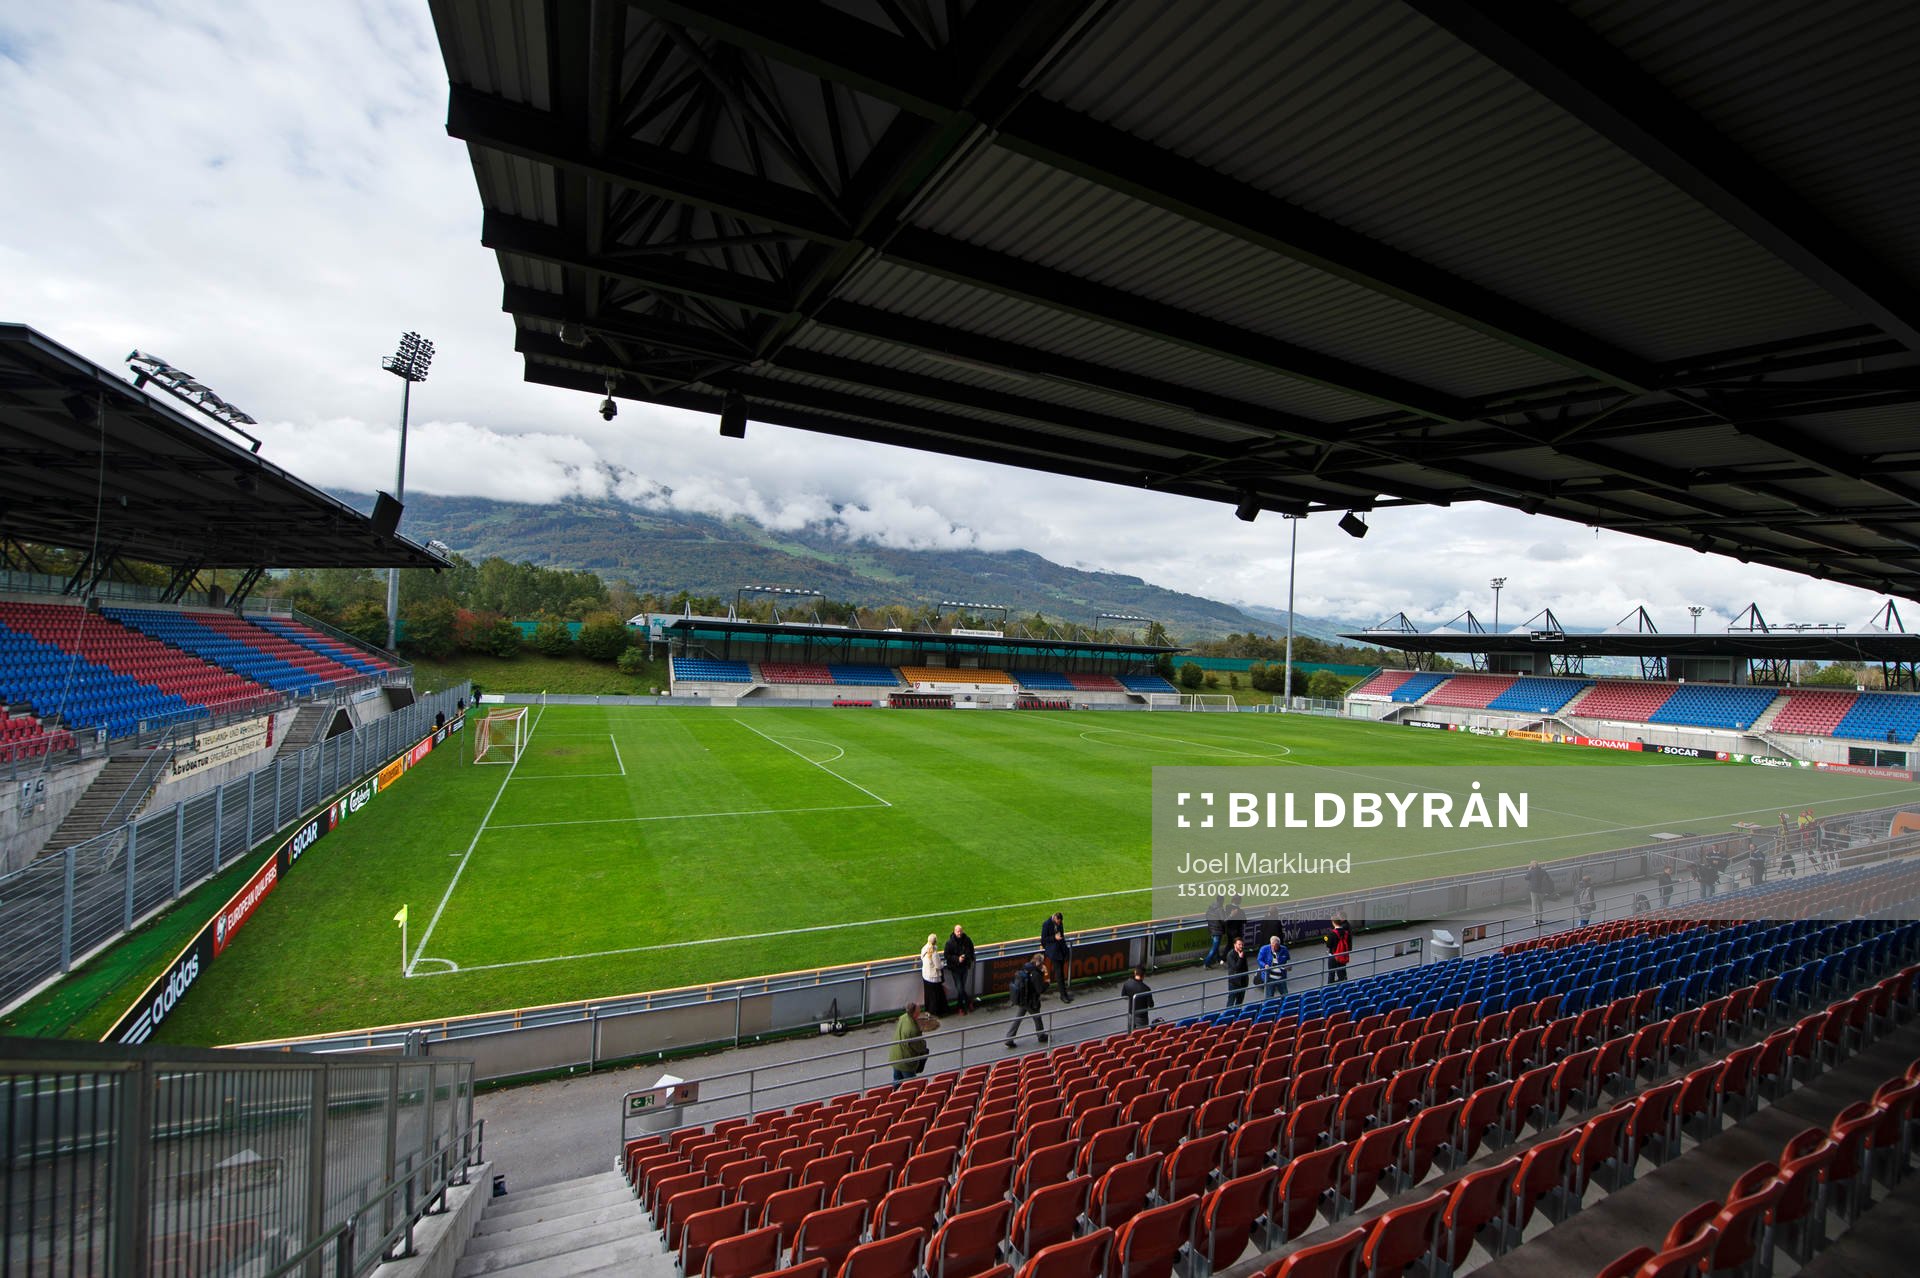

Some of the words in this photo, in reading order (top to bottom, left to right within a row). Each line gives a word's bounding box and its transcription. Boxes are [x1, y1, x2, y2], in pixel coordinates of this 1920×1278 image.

[1588, 738, 1629, 750] KONAMI
[1663, 747, 1699, 757] SOCAR
[1750, 755, 1792, 767] Carlsberg
[1829, 765, 1867, 775] EUROPEAN
[1868, 769, 1909, 779] QUALIFIERS
[350, 782, 371, 813] Carlsberg
[292, 821, 318, 859] SOCAR
[228, 889, 255, 931] EUROPEAN
[254, 864, 277, 902] QUALIFIERS
[151, 952, 199, 1025] adidas
